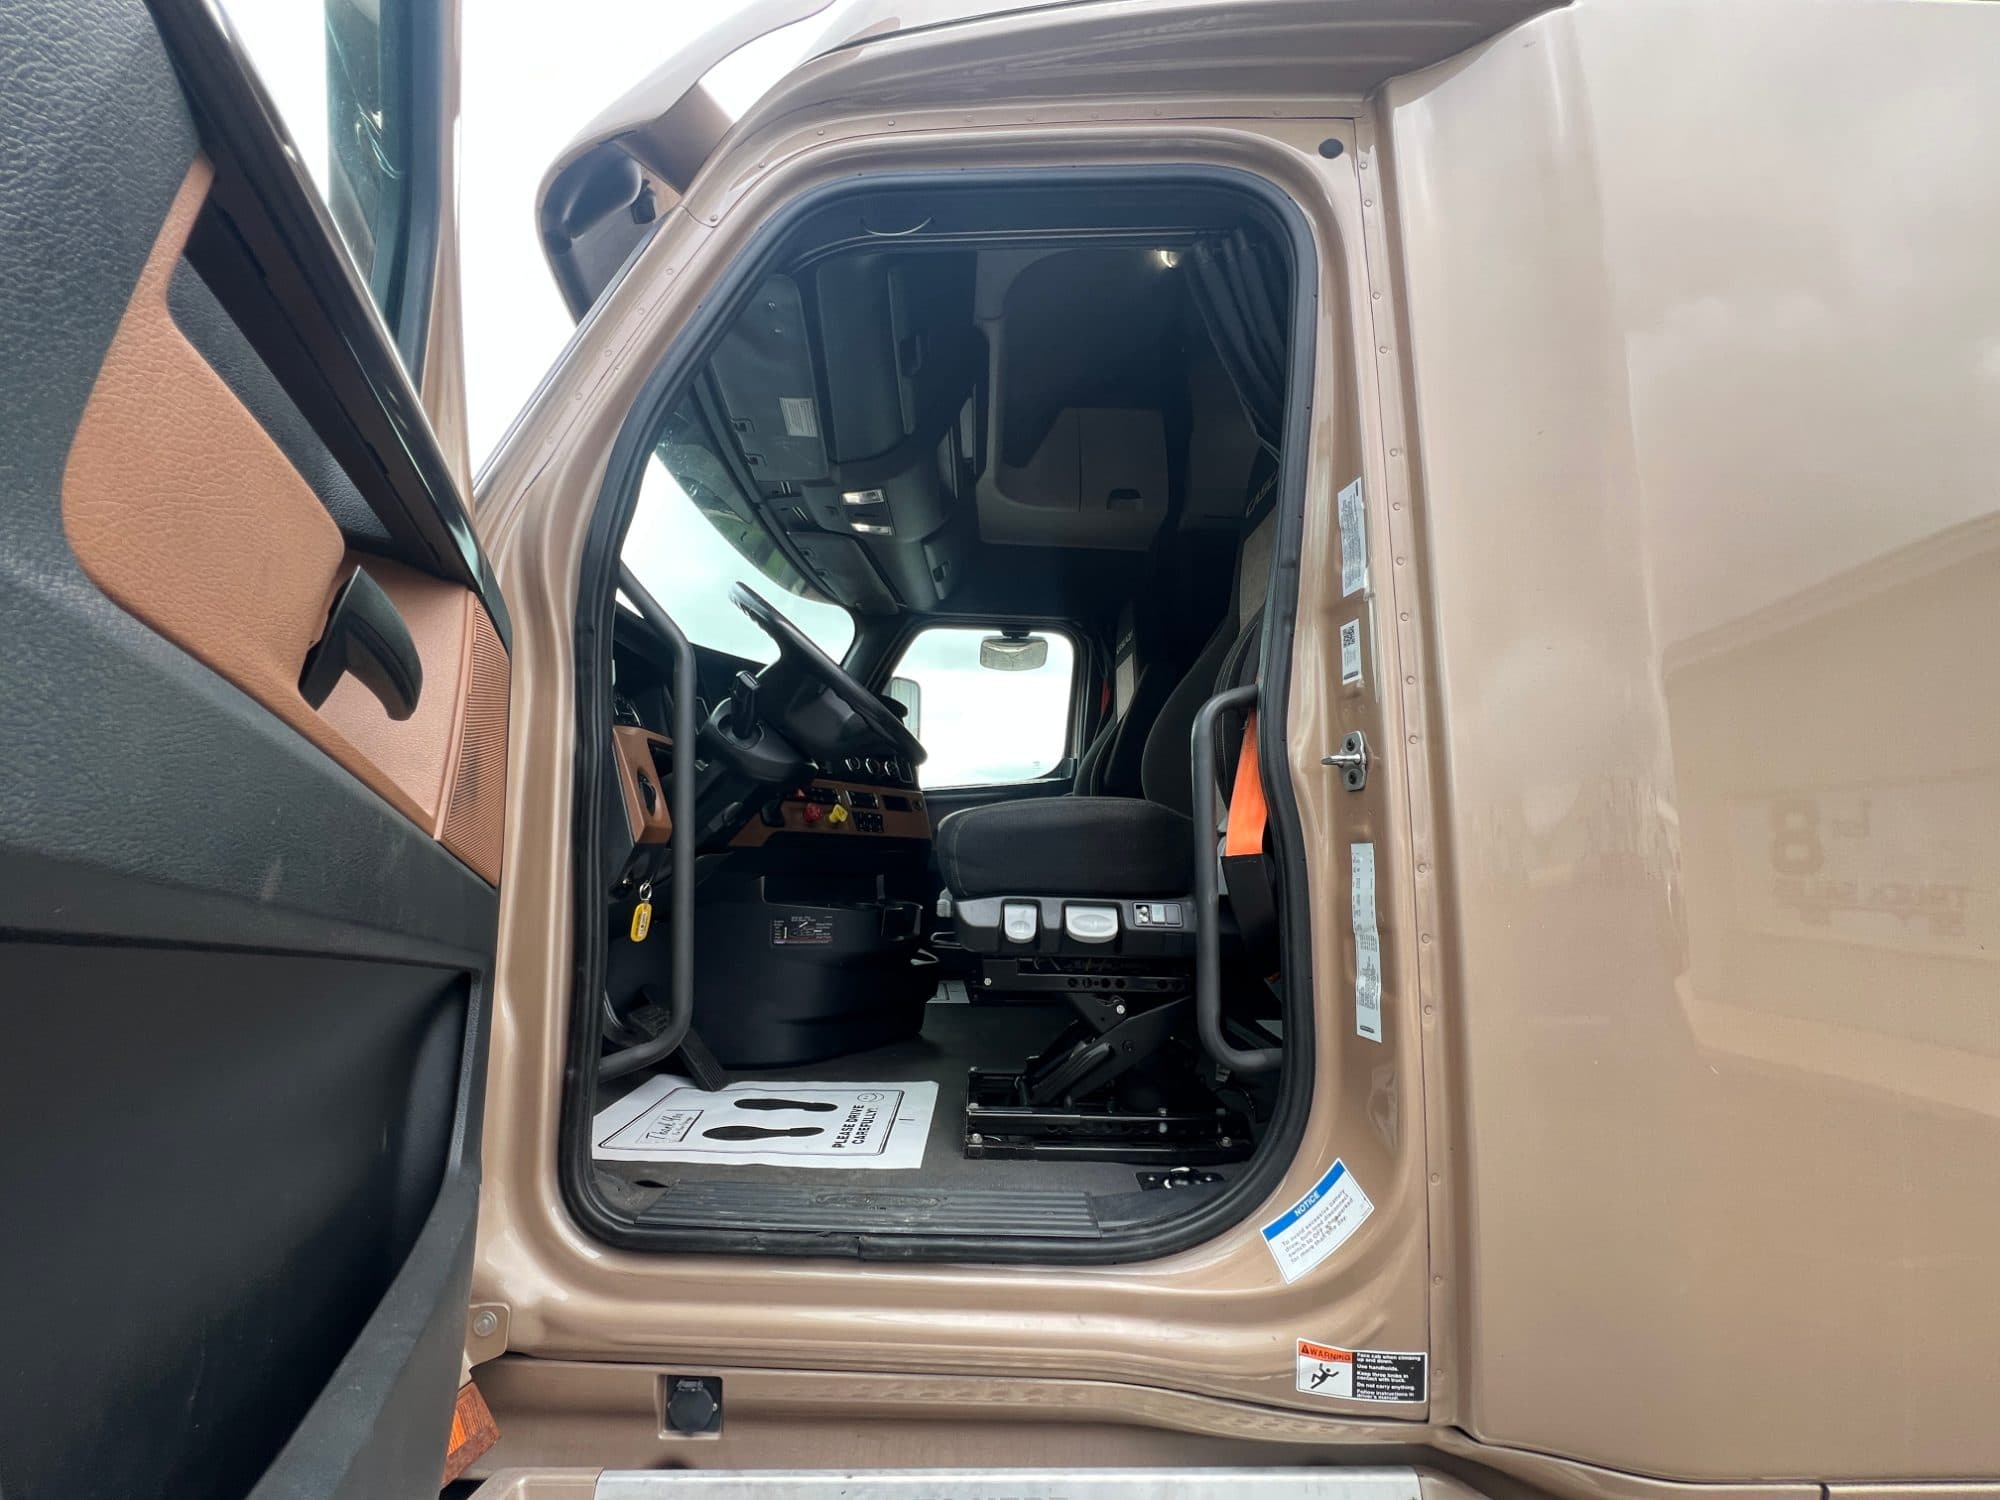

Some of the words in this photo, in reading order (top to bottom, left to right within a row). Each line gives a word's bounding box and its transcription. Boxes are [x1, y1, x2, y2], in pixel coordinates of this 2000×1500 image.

[832, 1123, 855, 1148] PLEASE
[845, 1105, 864, 1123] DRIVE
[1294, 1190, 1320, 1217] NOTICE
[1310, 1347, 1351, 1361] WARNING
